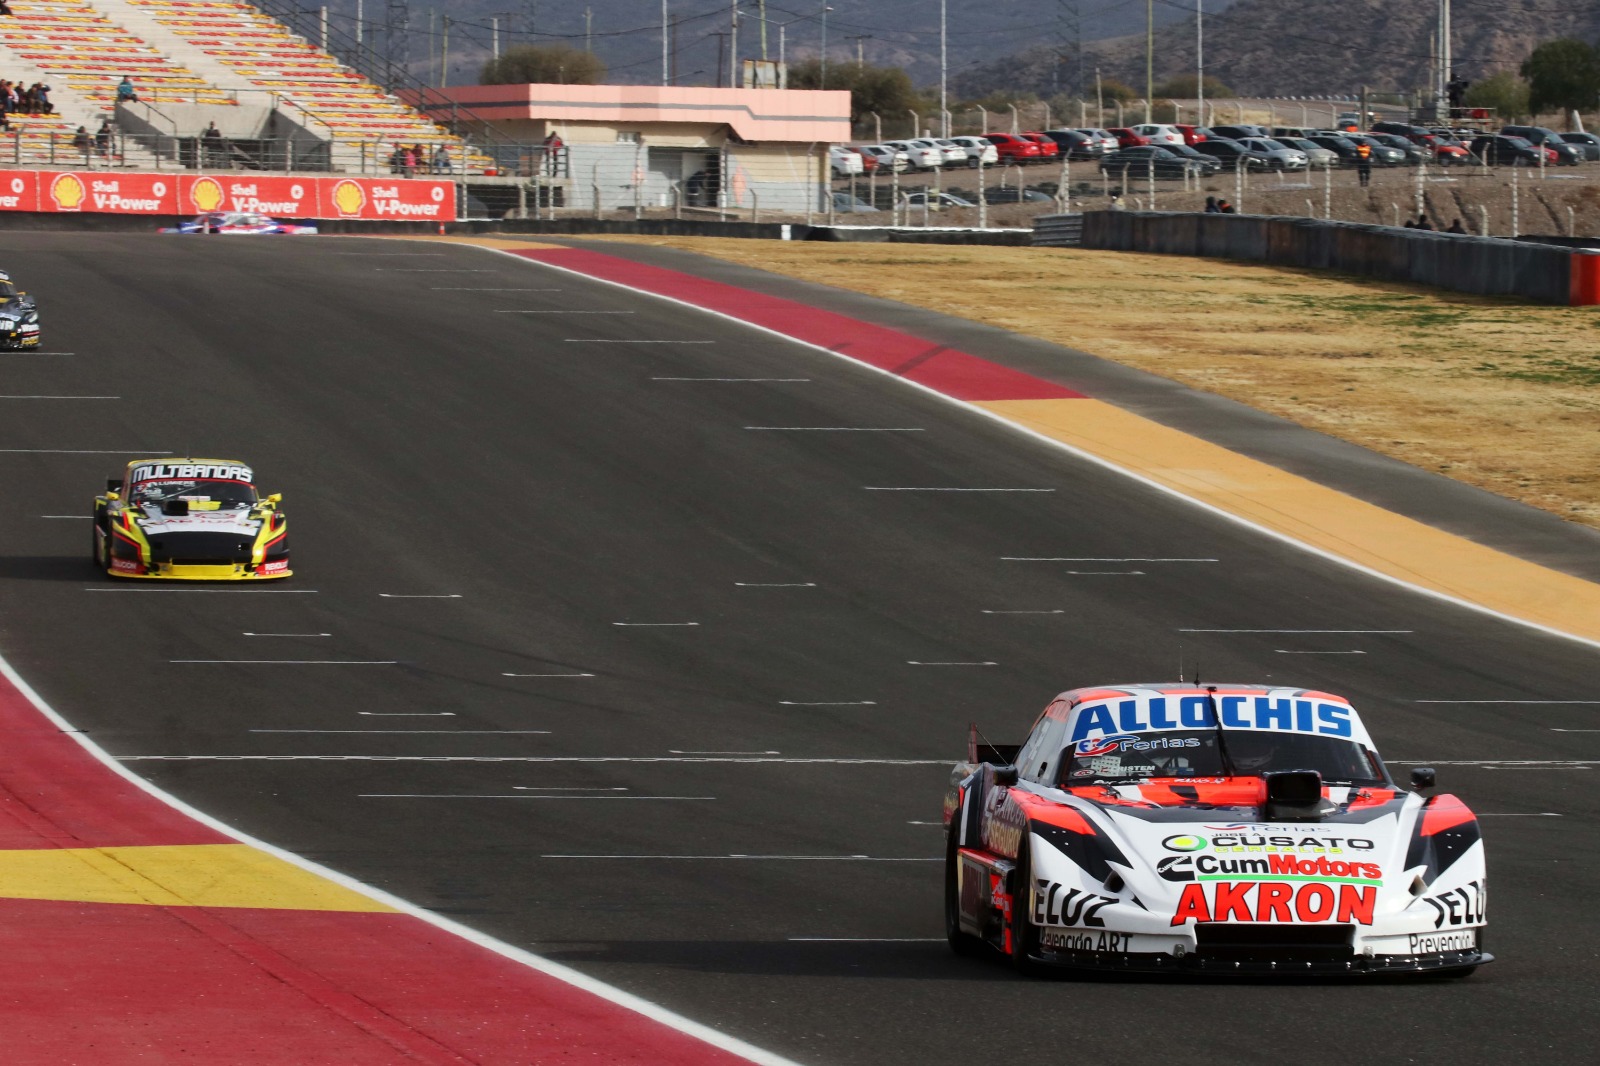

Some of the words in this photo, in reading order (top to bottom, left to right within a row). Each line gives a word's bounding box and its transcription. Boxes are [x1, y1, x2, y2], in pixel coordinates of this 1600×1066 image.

[92, 181, 119, 193] Shell
[231, 183, 257, 196] Shell
[372, 187, 398, 198] Shell
[94, 194, 161, 210] V-Power
[232, 197, 299, 213] V-Power
[374, 200, 440, 215] V-Power
[132, 465, 253, 483] MULTIBANDAS
[1070, 696, 1352, 742] ALLOCHIS
[1120, 737, 1200, 752] Ferias
[990, 820, 1022, 858] SEGURO
[1212, 836, 1374, 850] CUSATO
[1214, 846, 1343, 854] CEREALES
[1035, 878, 1119, 927] ELUZ
[1170, 882, 1377, 926] AKRON
[1422, 880, 1486, 930] JELU
[1097, 931, 1134, 953] ART
